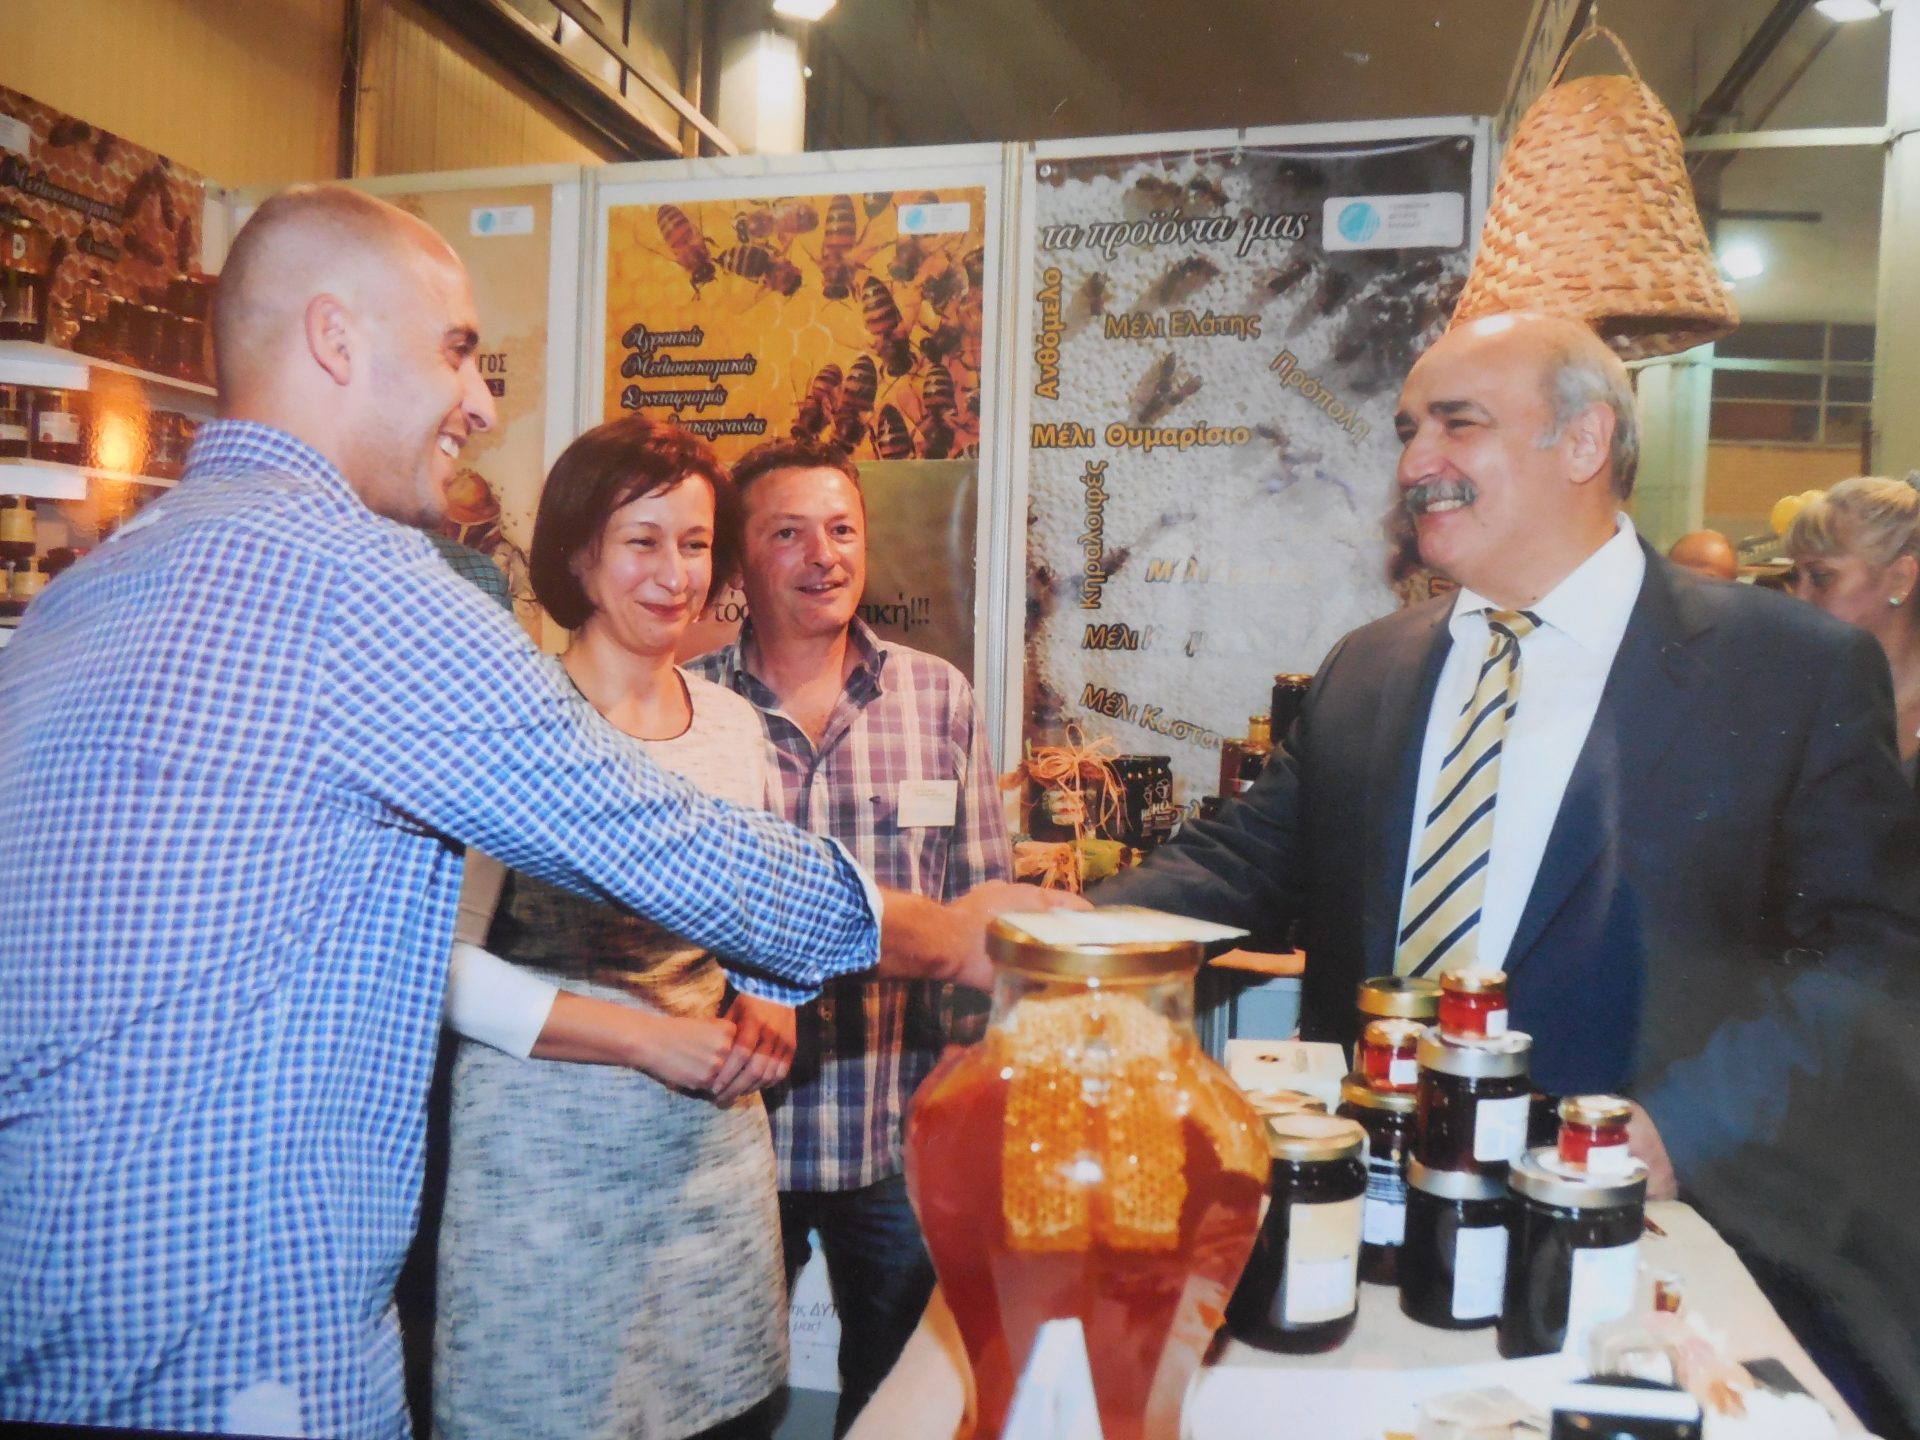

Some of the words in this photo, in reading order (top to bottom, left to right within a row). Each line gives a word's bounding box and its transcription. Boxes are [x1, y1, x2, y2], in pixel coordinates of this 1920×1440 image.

[1042, 222, 1084, 250] τα
[1085, 208, 1238, 260] προϊόντα
[1237, 210, 1310, 257] μας
[1035, 266, 1064, 400] Ανθόμελο
[1104, 311, 1165, 339] Μέλι
[1168, 310, 1262, 341] Ελάτης
[478, 353, 508, 373] ΓΟΣ
[1268, 348, 1371, 446] Πρόπολη
[1031, 423, 1095, 449] Μέλι
[1105, 421, 1252, 453] Θυμαρίσιο
[1145, 556, 1210, 583] Μλι
[1081, 623, 1138, 652] Μέλι
[1079, 683, 1137, 723] Μέλι
